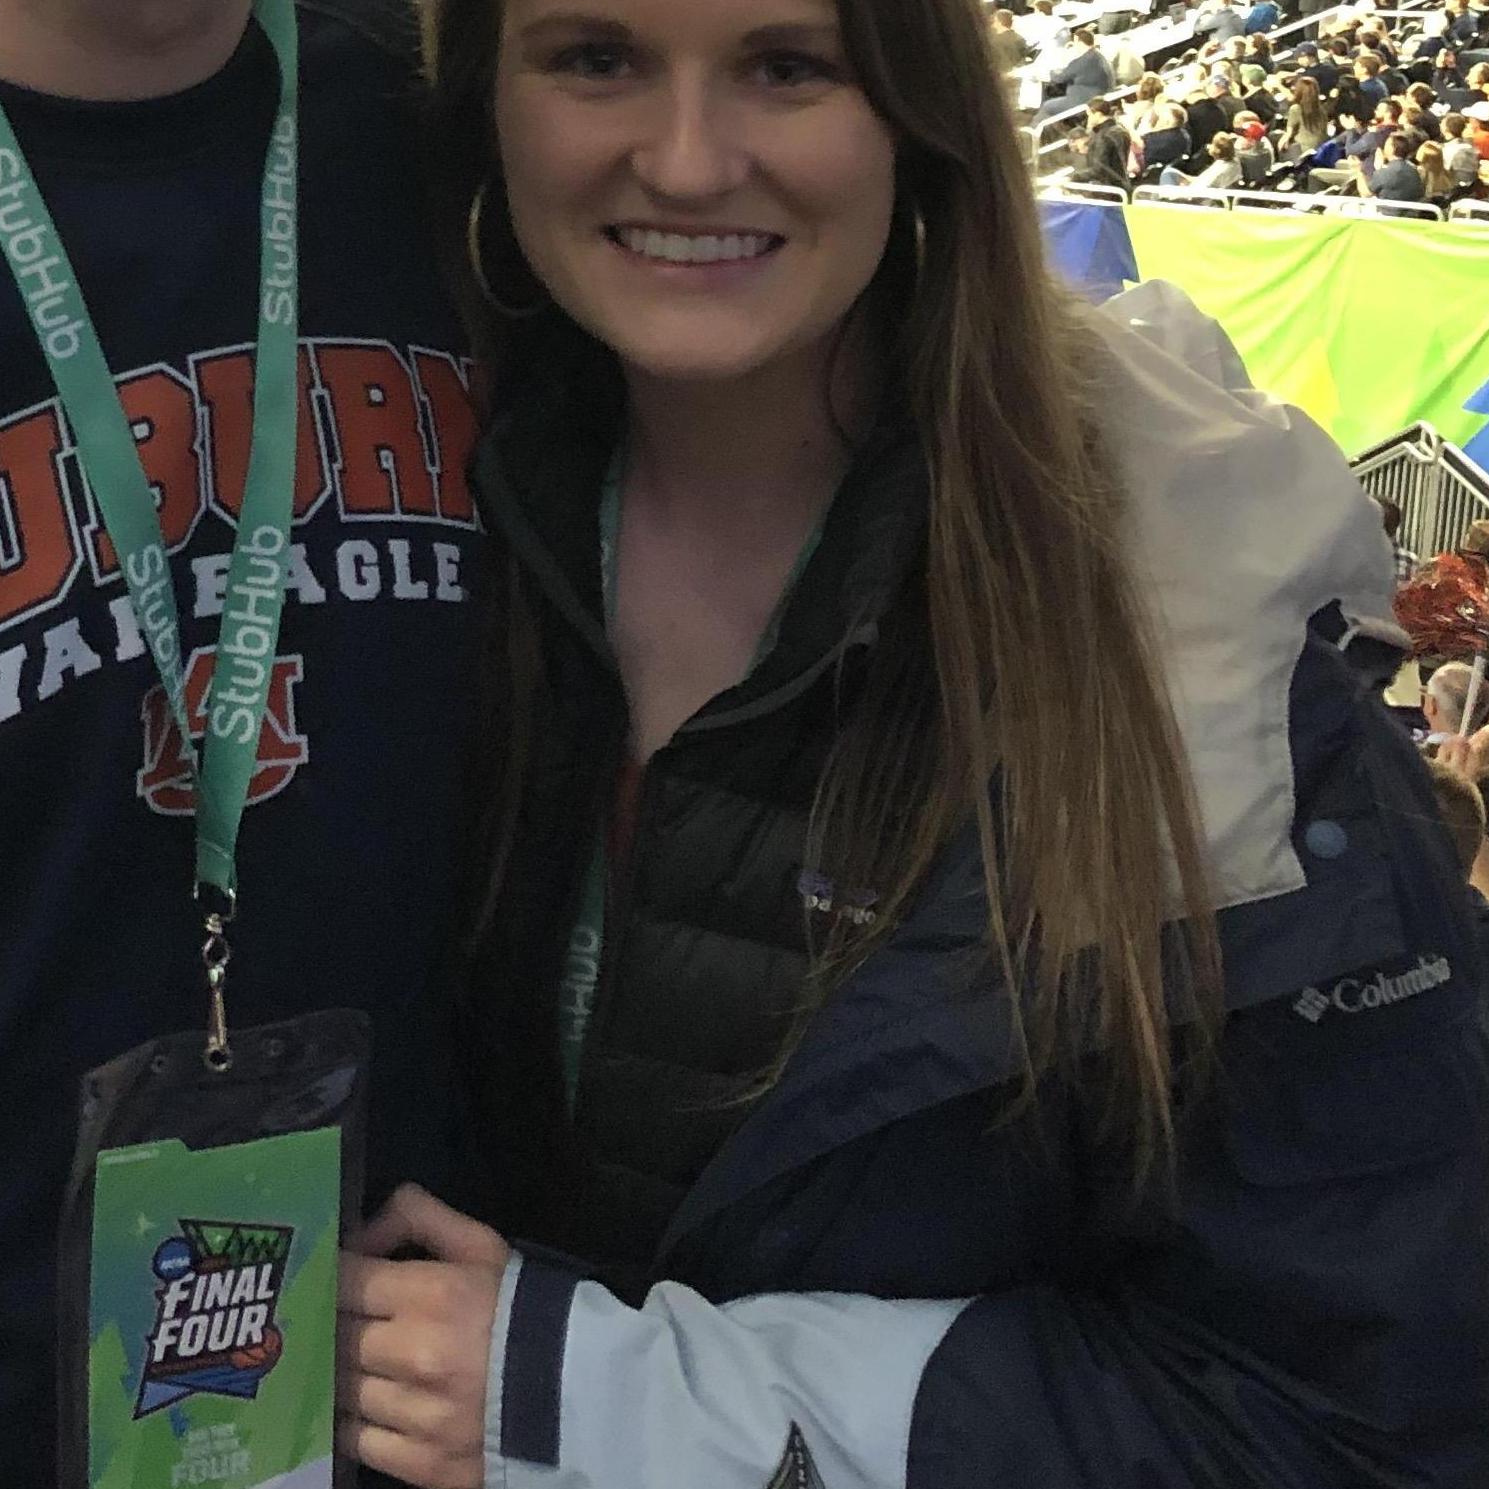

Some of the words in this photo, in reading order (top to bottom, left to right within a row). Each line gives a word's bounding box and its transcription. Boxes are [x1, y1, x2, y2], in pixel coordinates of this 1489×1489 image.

[263, 115, 296, 325] StubHub
[213, 524, 285, 745] StubHub
[152, 1302, 269, 1363] FOUR
[162, 1262, 274, 1320] FINAL
